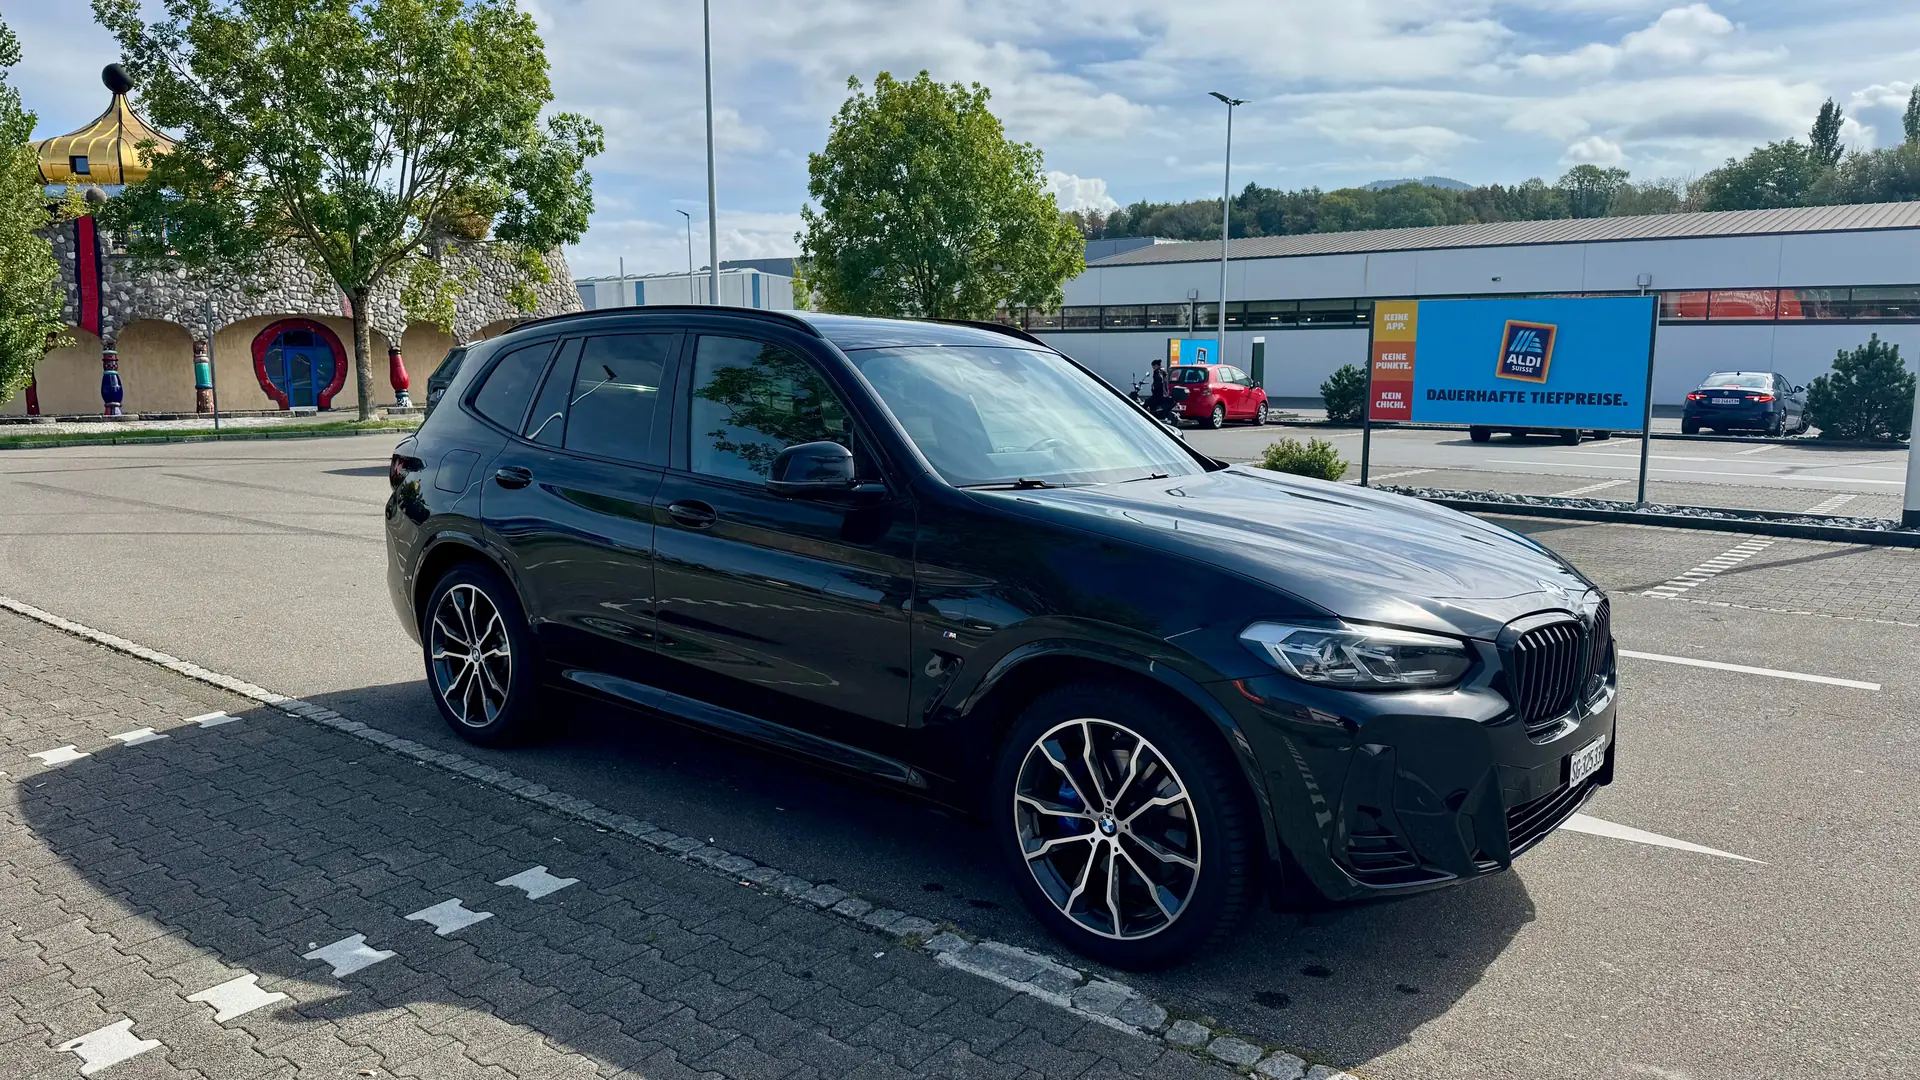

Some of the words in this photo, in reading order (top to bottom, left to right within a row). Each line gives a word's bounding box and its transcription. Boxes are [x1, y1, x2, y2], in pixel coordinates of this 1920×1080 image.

[1384, 313, 1408, 321] KEINE
[1386, 322, 1406, 330] APP.
[1381, 353, 1407, 361] KEINE
[1507, 354, 1541, 368] ALDI
[1375, 362, 1412, 370] PUNKTE.
[1511, 365, 1533, 373] SUISSE
[1381, 391, 1402, 400] KEIN
[1426, 388, 1526, 404] DAUERHAFTE
[1530, 391, 1628, 406] TIEFPREISE.
[1375, 400, 1407, 409] CHICHI.
